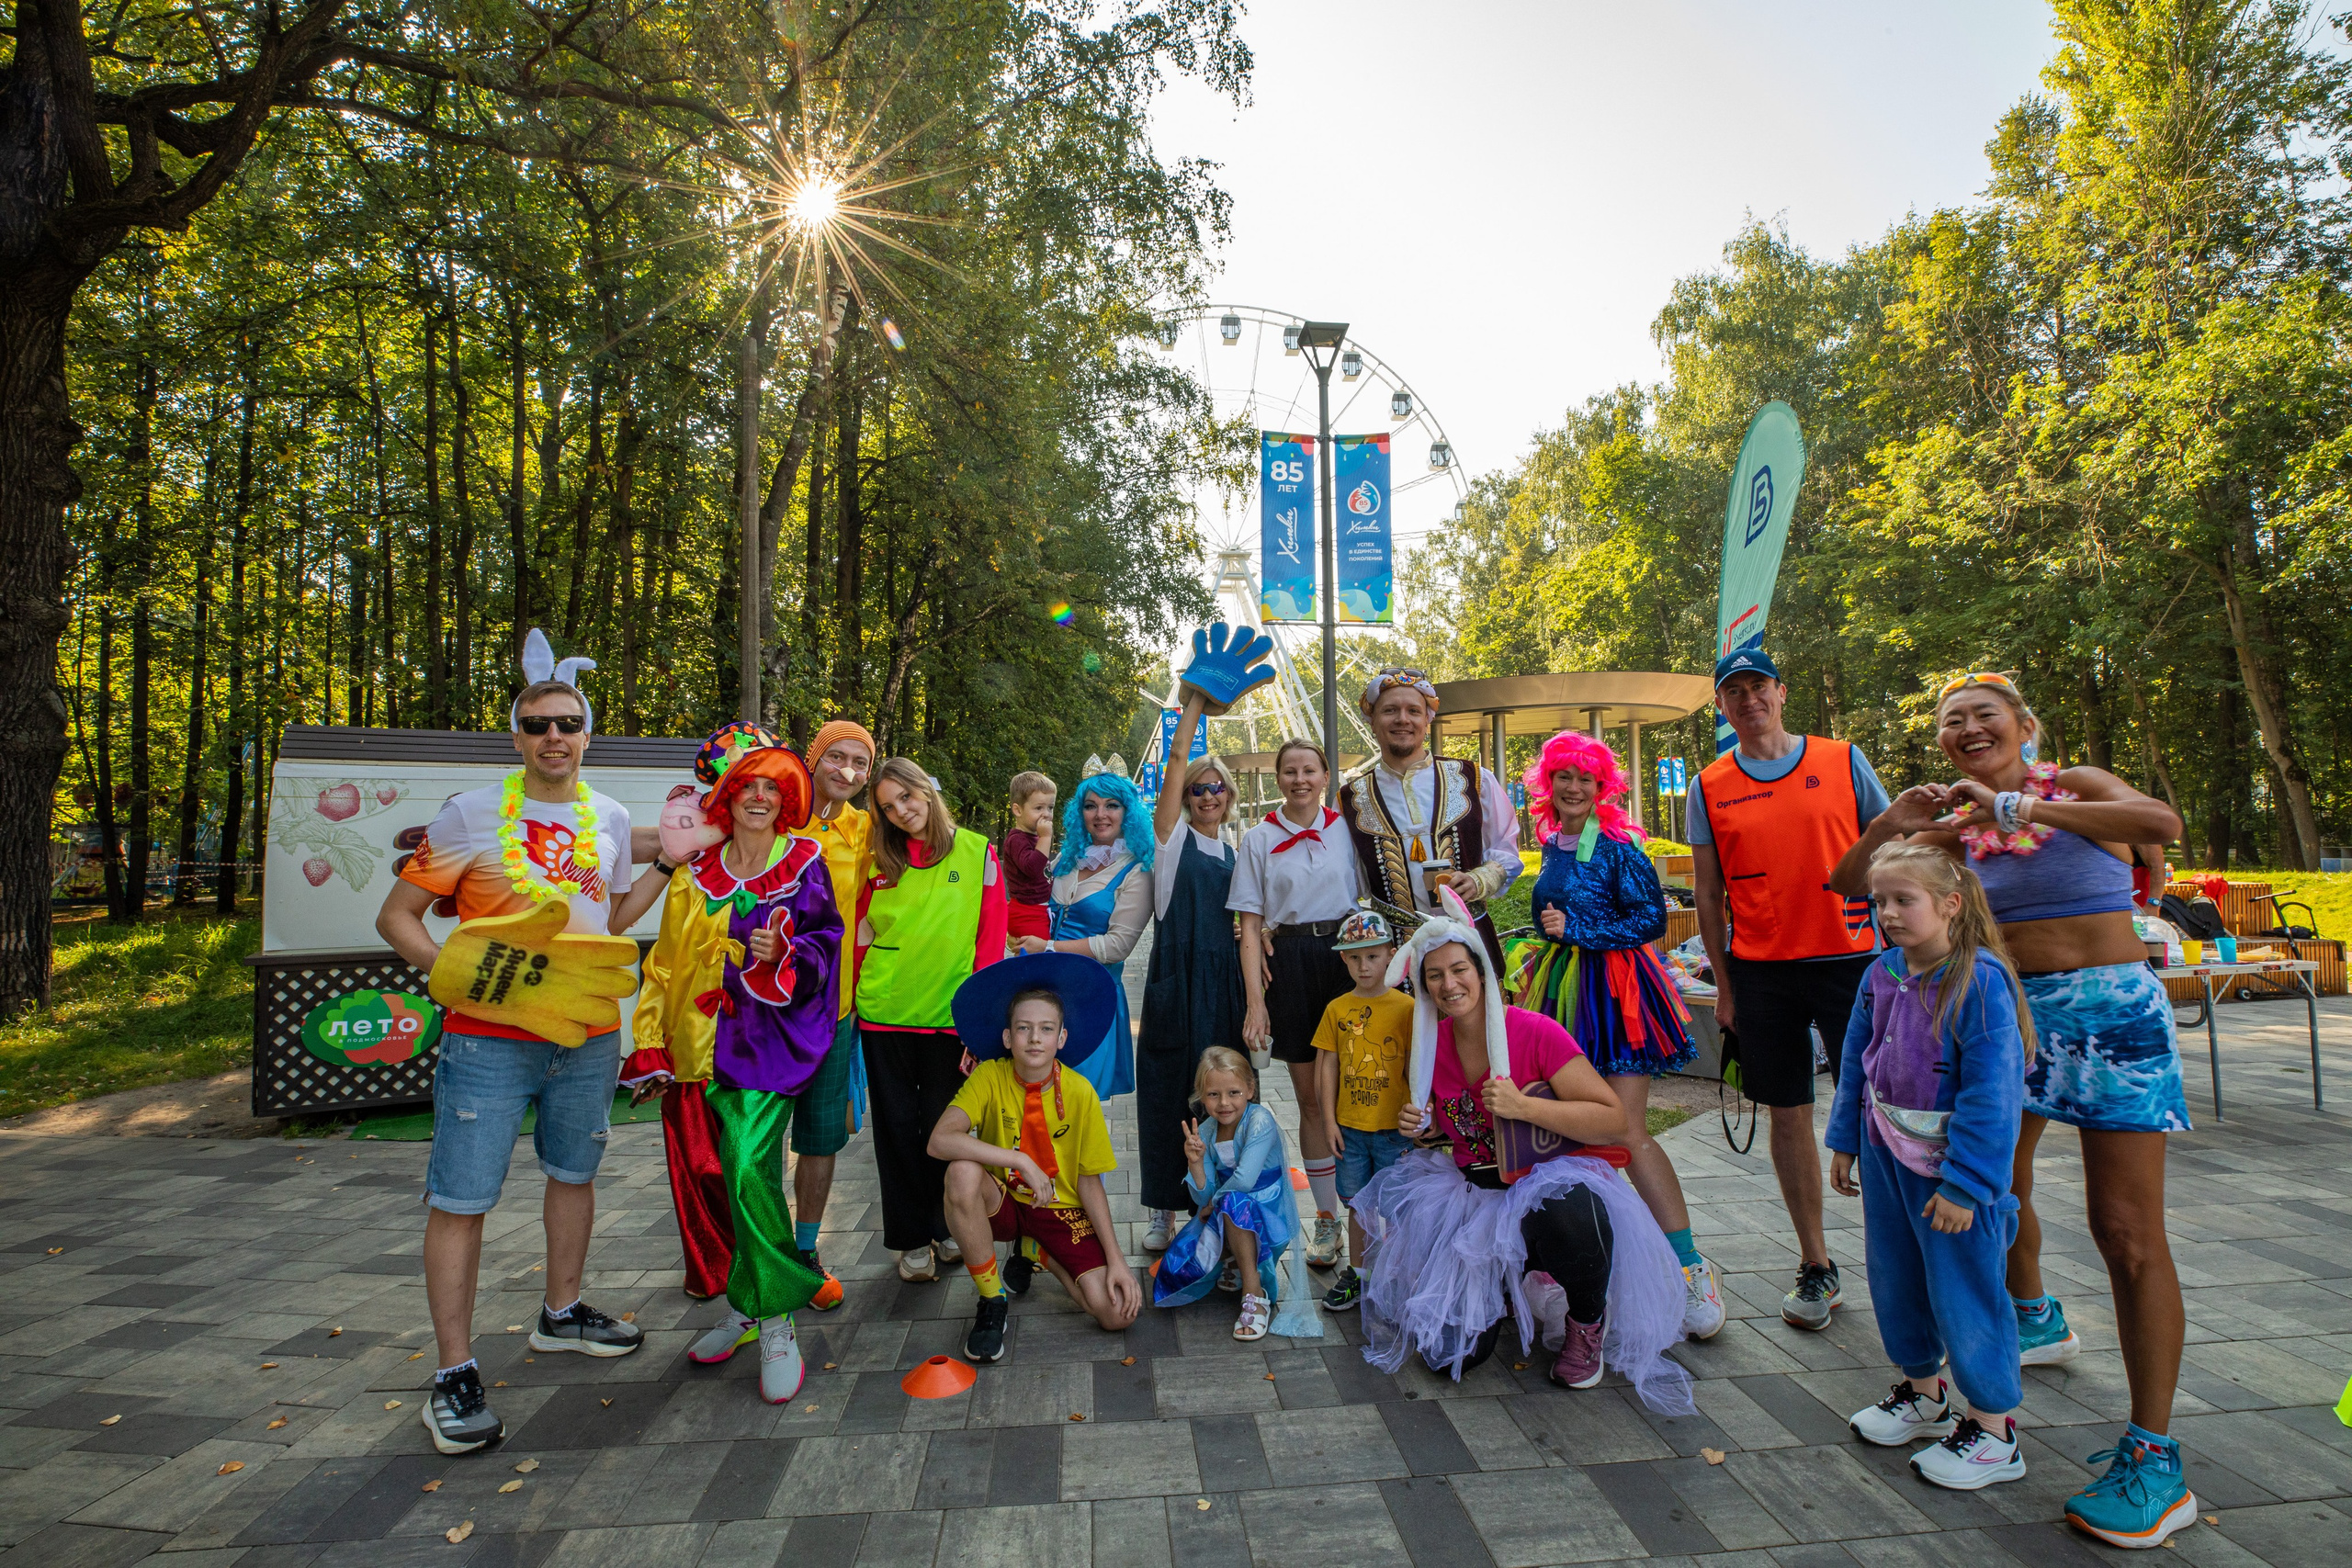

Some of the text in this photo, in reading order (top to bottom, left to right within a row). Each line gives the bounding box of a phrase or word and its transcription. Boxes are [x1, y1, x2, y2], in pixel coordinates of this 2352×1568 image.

[1270, 460, 1305, 483] 85
[1277, 484, 1298, 493] ЛЕТ
[1275, 506, 1301, 565] Химки
[1346, 519, 1382, 536] Химки
[1730, 660, 1753, 670] adidas
[1165, 716, 1178, 725] 85
[1716, 790, 1774, 809] Организатор
[467, 942, 508, 1003] Маркет
[488, 947, 527, 1005] Яндекс
[1344, 1075, 1389, 1091] FUTURE
[1351, 1089, 1379, 1107] KING
